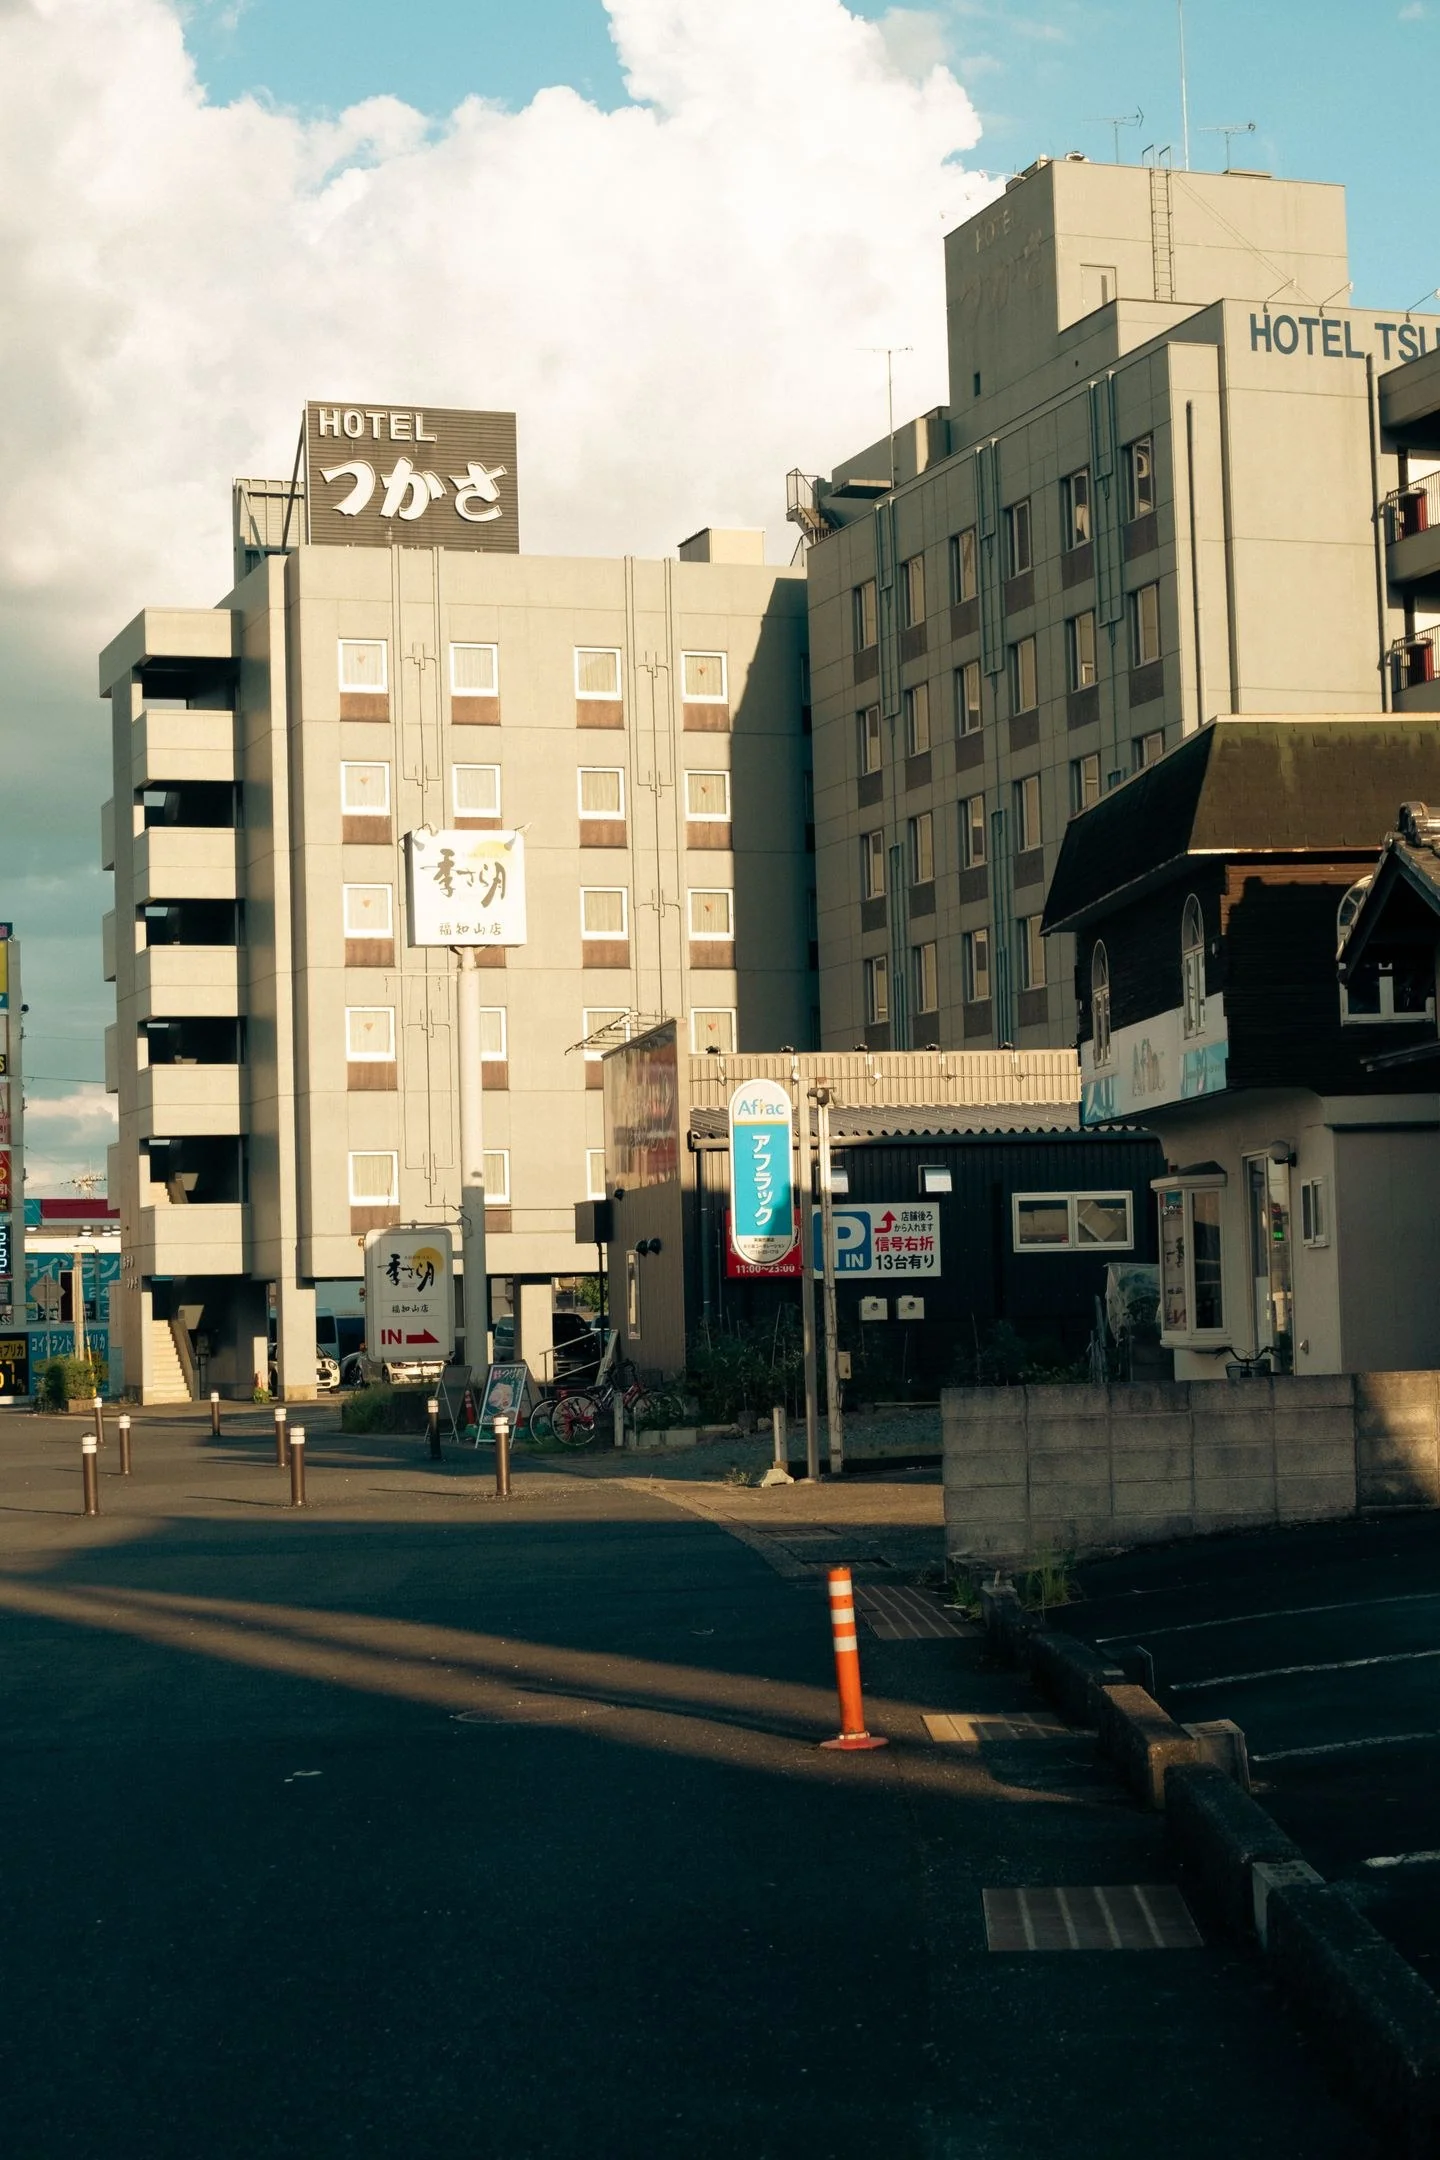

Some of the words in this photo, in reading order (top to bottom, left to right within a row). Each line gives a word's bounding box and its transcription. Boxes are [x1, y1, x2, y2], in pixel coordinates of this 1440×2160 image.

[1250, 313, 1365, 359] HOTEL
[319, 408, 437, 442] HOTEL
[319, 456, 508, 523] つかさ
[439, 922, 502, 936] 福知山店
[751, 1134, 773, 1227] アフラック
[901, 1210, 933, 1222] 店舗後ろ
[894, 1223, 934, 1233] から入れます
[831, 1216, 866, 1268] P
[875, 1235, 934, 1252] 信号右折
[845, 1253, 864, 1268] IN
[875, 1254, 935, 1270] 13台有り
[392, 1303, 429, 1314] 福知山店
[381, 1329, 402, 1345] IN
